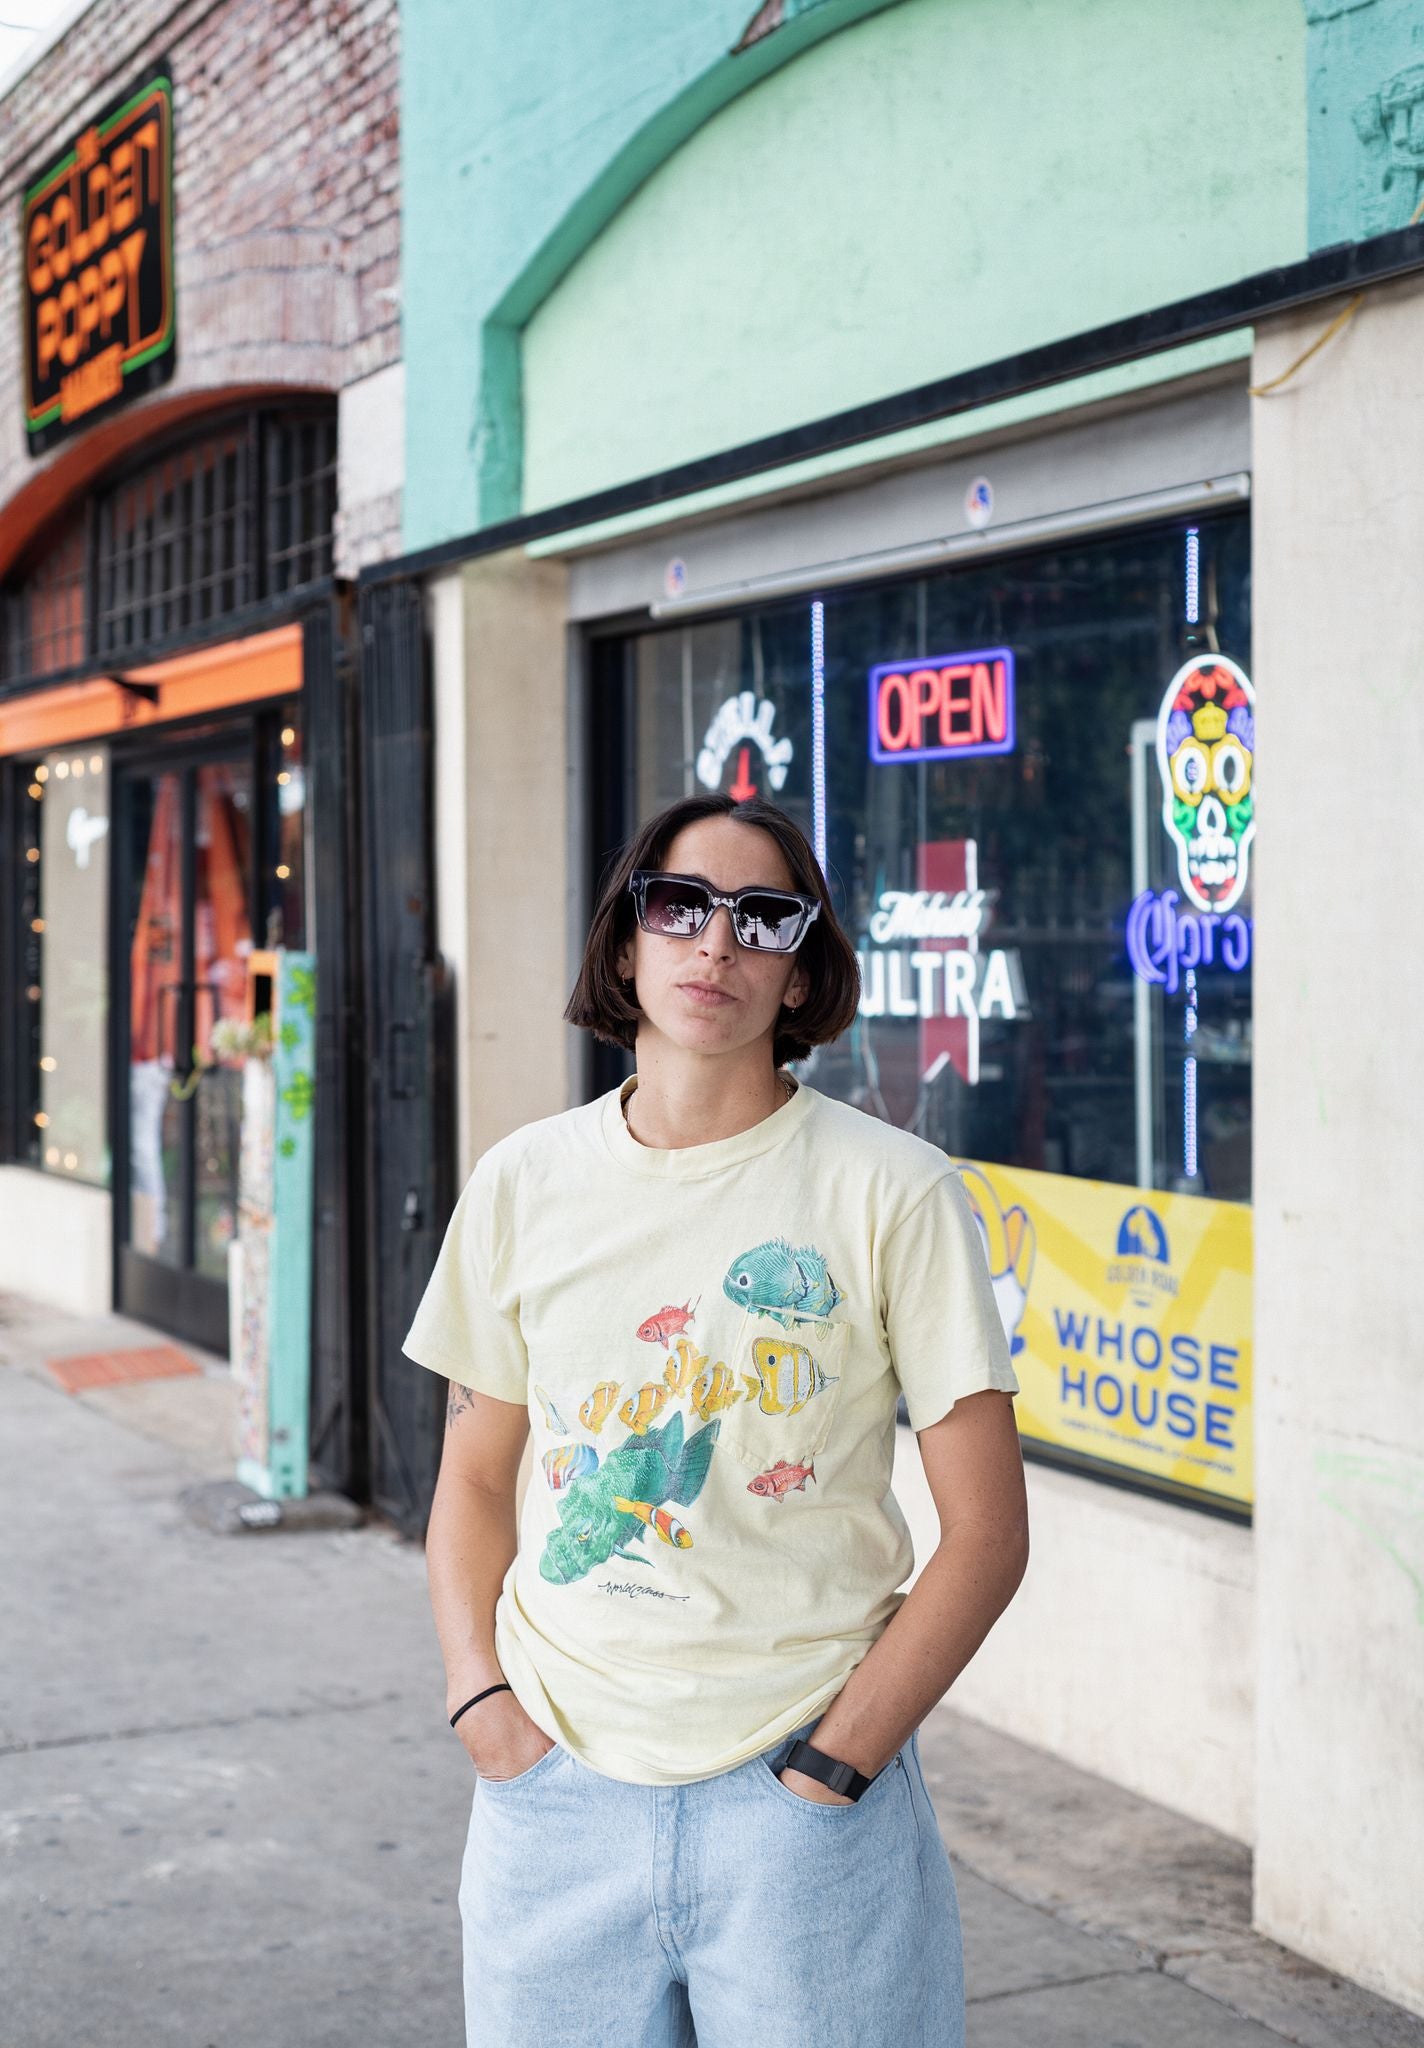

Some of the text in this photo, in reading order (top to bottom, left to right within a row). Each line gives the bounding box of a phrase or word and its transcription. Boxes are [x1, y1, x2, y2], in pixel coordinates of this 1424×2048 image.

[37, 229, 147, 382] POPPY
[878, 659, 1007, 752] OPEN
[856, 949, 1017, 1020] ULTRA
[1126, 889, 1253, 994] Coro
[1054, 1307, 1240, 1391] WHOSE
[1061, 1364, 1236, 1450] HOUSE
